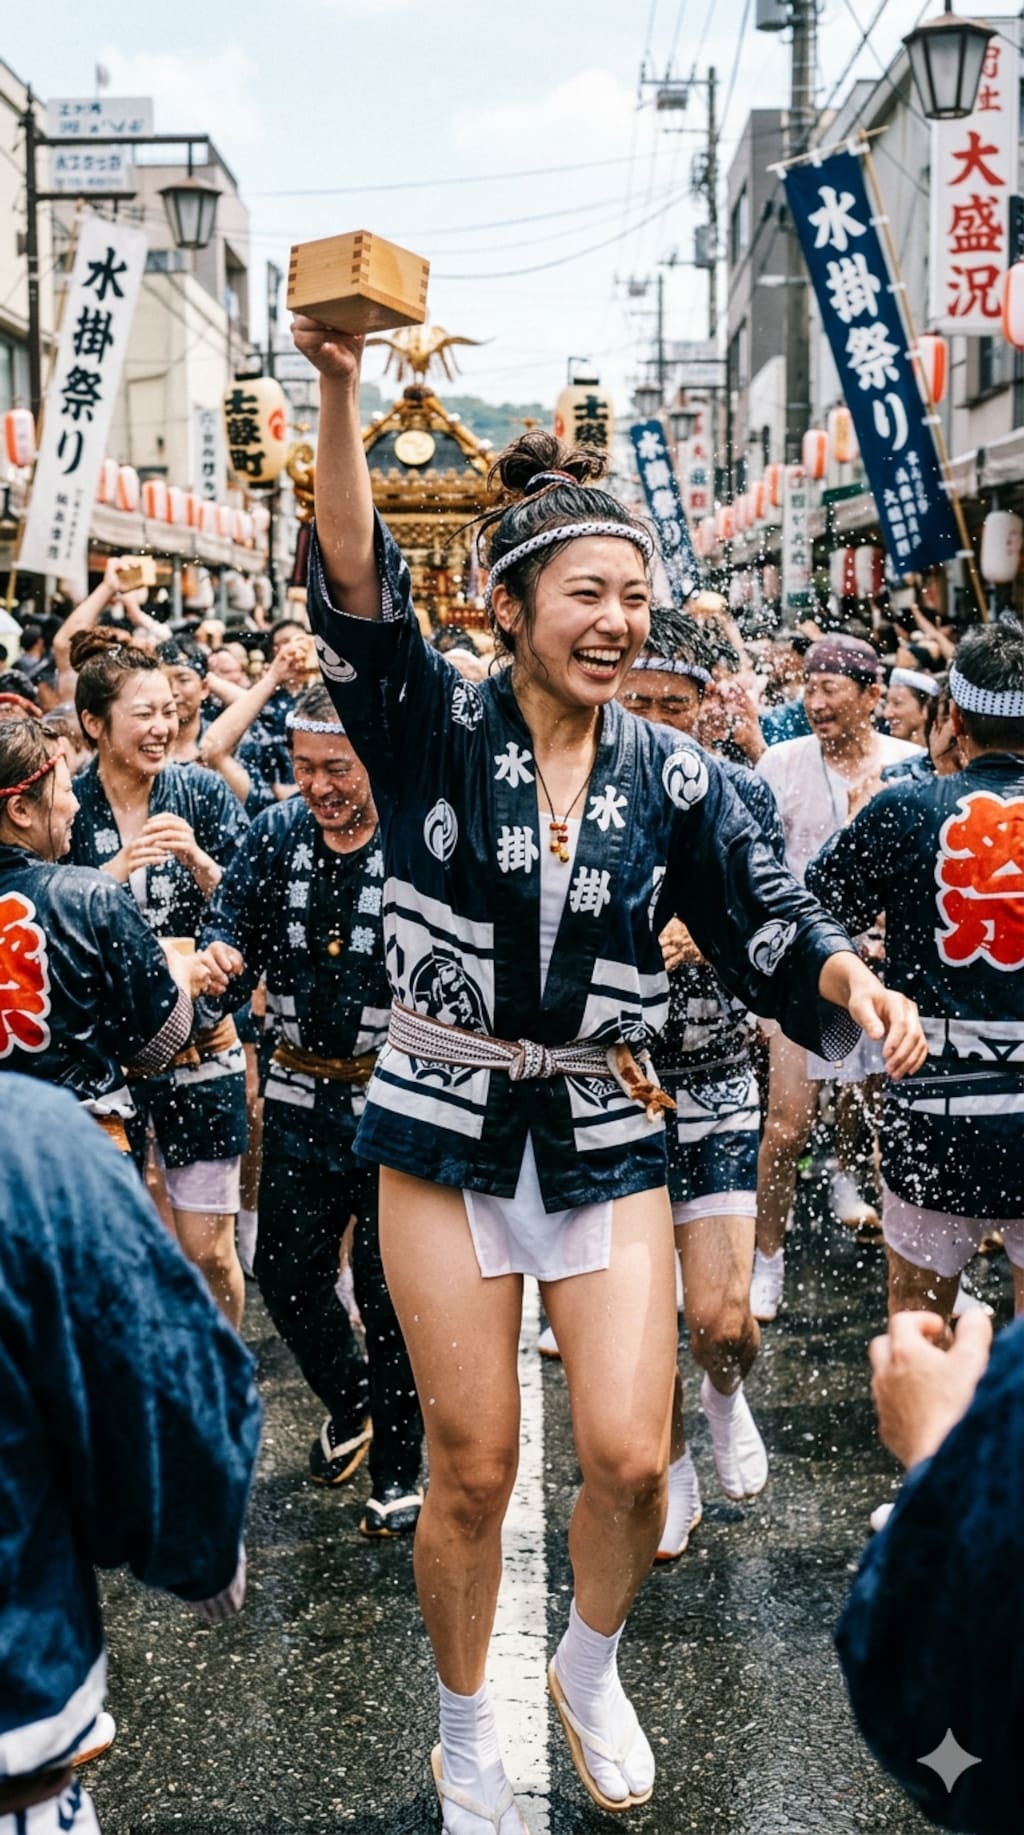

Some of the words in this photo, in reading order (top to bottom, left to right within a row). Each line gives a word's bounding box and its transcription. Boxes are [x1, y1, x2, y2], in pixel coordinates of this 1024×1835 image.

[57, 246, 128, 475] 水掛祭り
[807, 185, 909, 451] 水掛祭り
[494, 741, 540, 874] 水掛
[569, 785, 629, 918] 水掛
